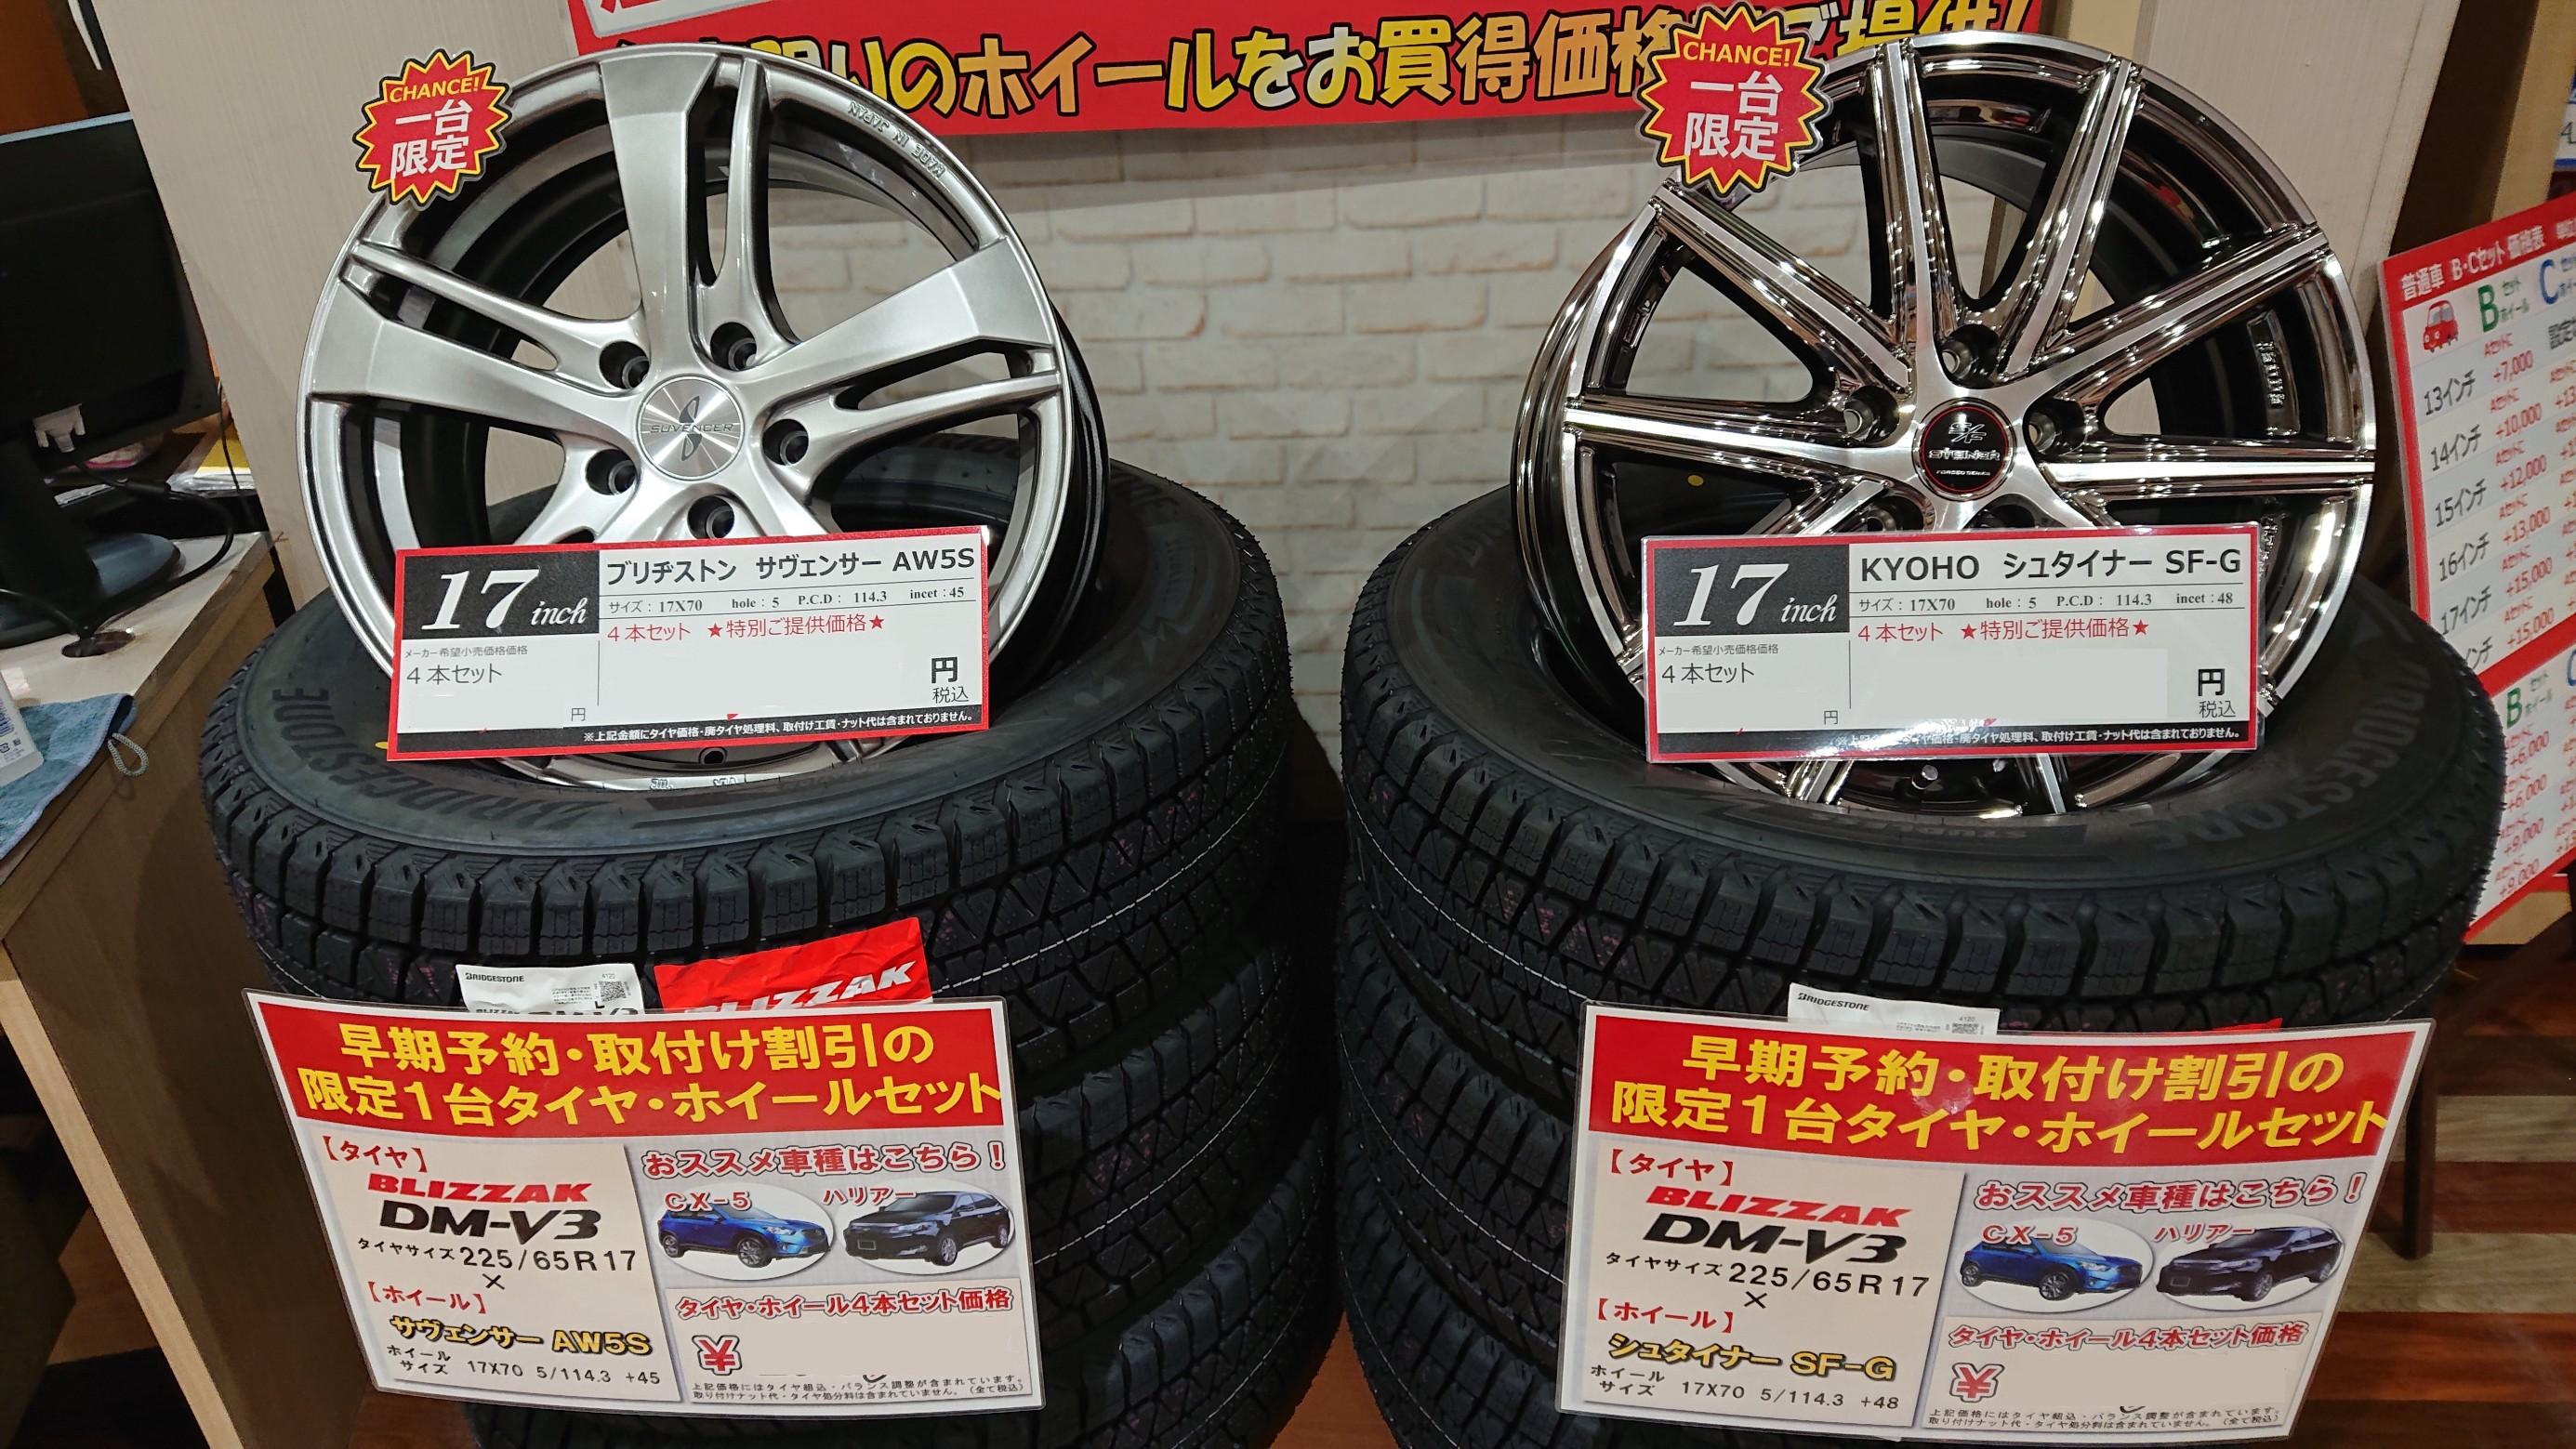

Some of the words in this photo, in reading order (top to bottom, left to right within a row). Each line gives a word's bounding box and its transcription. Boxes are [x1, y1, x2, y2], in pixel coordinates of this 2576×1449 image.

[1682, 40, 1791, 68] CHANCE!
[389, 76, 482, 103] CHANCE!
[1688, 71, 1784, 118] 一台
[394, 99, 470, 140] 一台
[849, 101, 891, 134] JAPAN
[892, 129, 916, 148] IN
[1684, 113, 1781, 163] 限定
[389, 136, 470, 178] 限定
[911, 143, 946, 178] MADE
[2540, 259, 2559, 305] C
[2477, 284, 2500, 333] B
[2424, 369, 2477, 416] 13インチ
[2430, 424, 2482, 471] 14インチ
[2435, 478, 2487, 527] 15インチ
[607, 558, 737, 586] ブリヂストン
[755, 552, 882, 580] サヴェンサー
[892, 547, 975, 573] AW5S
[1861, 554, 1980, 582] KYOHO
[2002, 548, 2153, 579] シュタイナー
[2165, 548, 2241, 575] SF-G
[2439, 532, 2490, 582] 16インチ
[421, 566, 540, 631] 17
[530, 598, 588, 626] inch
[658, 599, 703, 613] 17X70
[853, 591, 888, 604] 114.3
[1673, 562, 1790, 626] 17
[1781, 593, 1839, 625] inch
[1909, 598, 1956, 612] 17X70
[2116, 594, 2153, 607] 114.3
[2441, 585, 2492, 636] 17インチ
[406, 663, 503, 685] 4本セット
[931, 656, 958, 684] 円
[1661, 662, 1755, 684] 4本セット
[2197, 667, 2226, 697] 円
[932, 685, 970, 705] 税込
[2199, 700, 2237, 718] 税込
[2506, 687, 2524, 729] B
[571, 707, 587, 722] 円
[1823, 710, 1839, 725] 円
[466, 972, 525, 983] BRIDGESTONE
[1798, 993, 1870, 1011] BRIDGESTONE
[338, 1022, 935, 1077] 早期予約・取付け割引の
[1681, 1034, 2345, 1102] 早期予約・取付け割引の
[297, 1067, 1002, 1127] 限定1台タイヤ・ホイールセット
[1611, 1080, 2388, 1154] 限定1台タイヤ・ホイールセット
[368, 1173, 593, 1204] BLIZZAK
[664, 1191, 753, 1212] CX-5
[822, 1186, 918, 1206] ハリアー
[379, 1200, 602, 1245] DM-V3
[1645, 1185, 1913, 1228] BLIZZAK
[358, 1237, 456, 1261] タイヤサイズ
[1642, 1212, 1908, 1265] DM-V3
[1981, 1223, 2080, 1246] CX-5
[2152, 1222, 2257, 1244] ハリアー
[1605, 1252, 1724, 1277] タイヤサイズ
[676, 1286, 1015, 1321] タイヤ・ホイール4本セット価格
[389, 1315, 544, 1349] サヴェンサー
[552, 1330, 654, 1356] AW5S
[1949, 1321, 2310, 1351] タイヤ・ホイール4本セット価格
[387, 1345, 451, 1362] ホイール
[1608, 1332, 1783, 1371] シュタイナー
[1790, 1350, 1897, 1382] SF-G
[401, 1360, 449, 1376] サイズ
[467, 1360, 524, 1377] 17X70
[536, 1365, 612, 1383] 5/114.3
[625, 1371, 662, 1385] +45
[1590, 1364, 1666, 1383] ホイール
[1599, 1380, 1656, 1397] サイズ
[1681, 1380, 1746, 1400] 17X70
[1760, 1389, 1844, 1407] 5/114.3
[1860, 1395, 1900, 1410] +48
